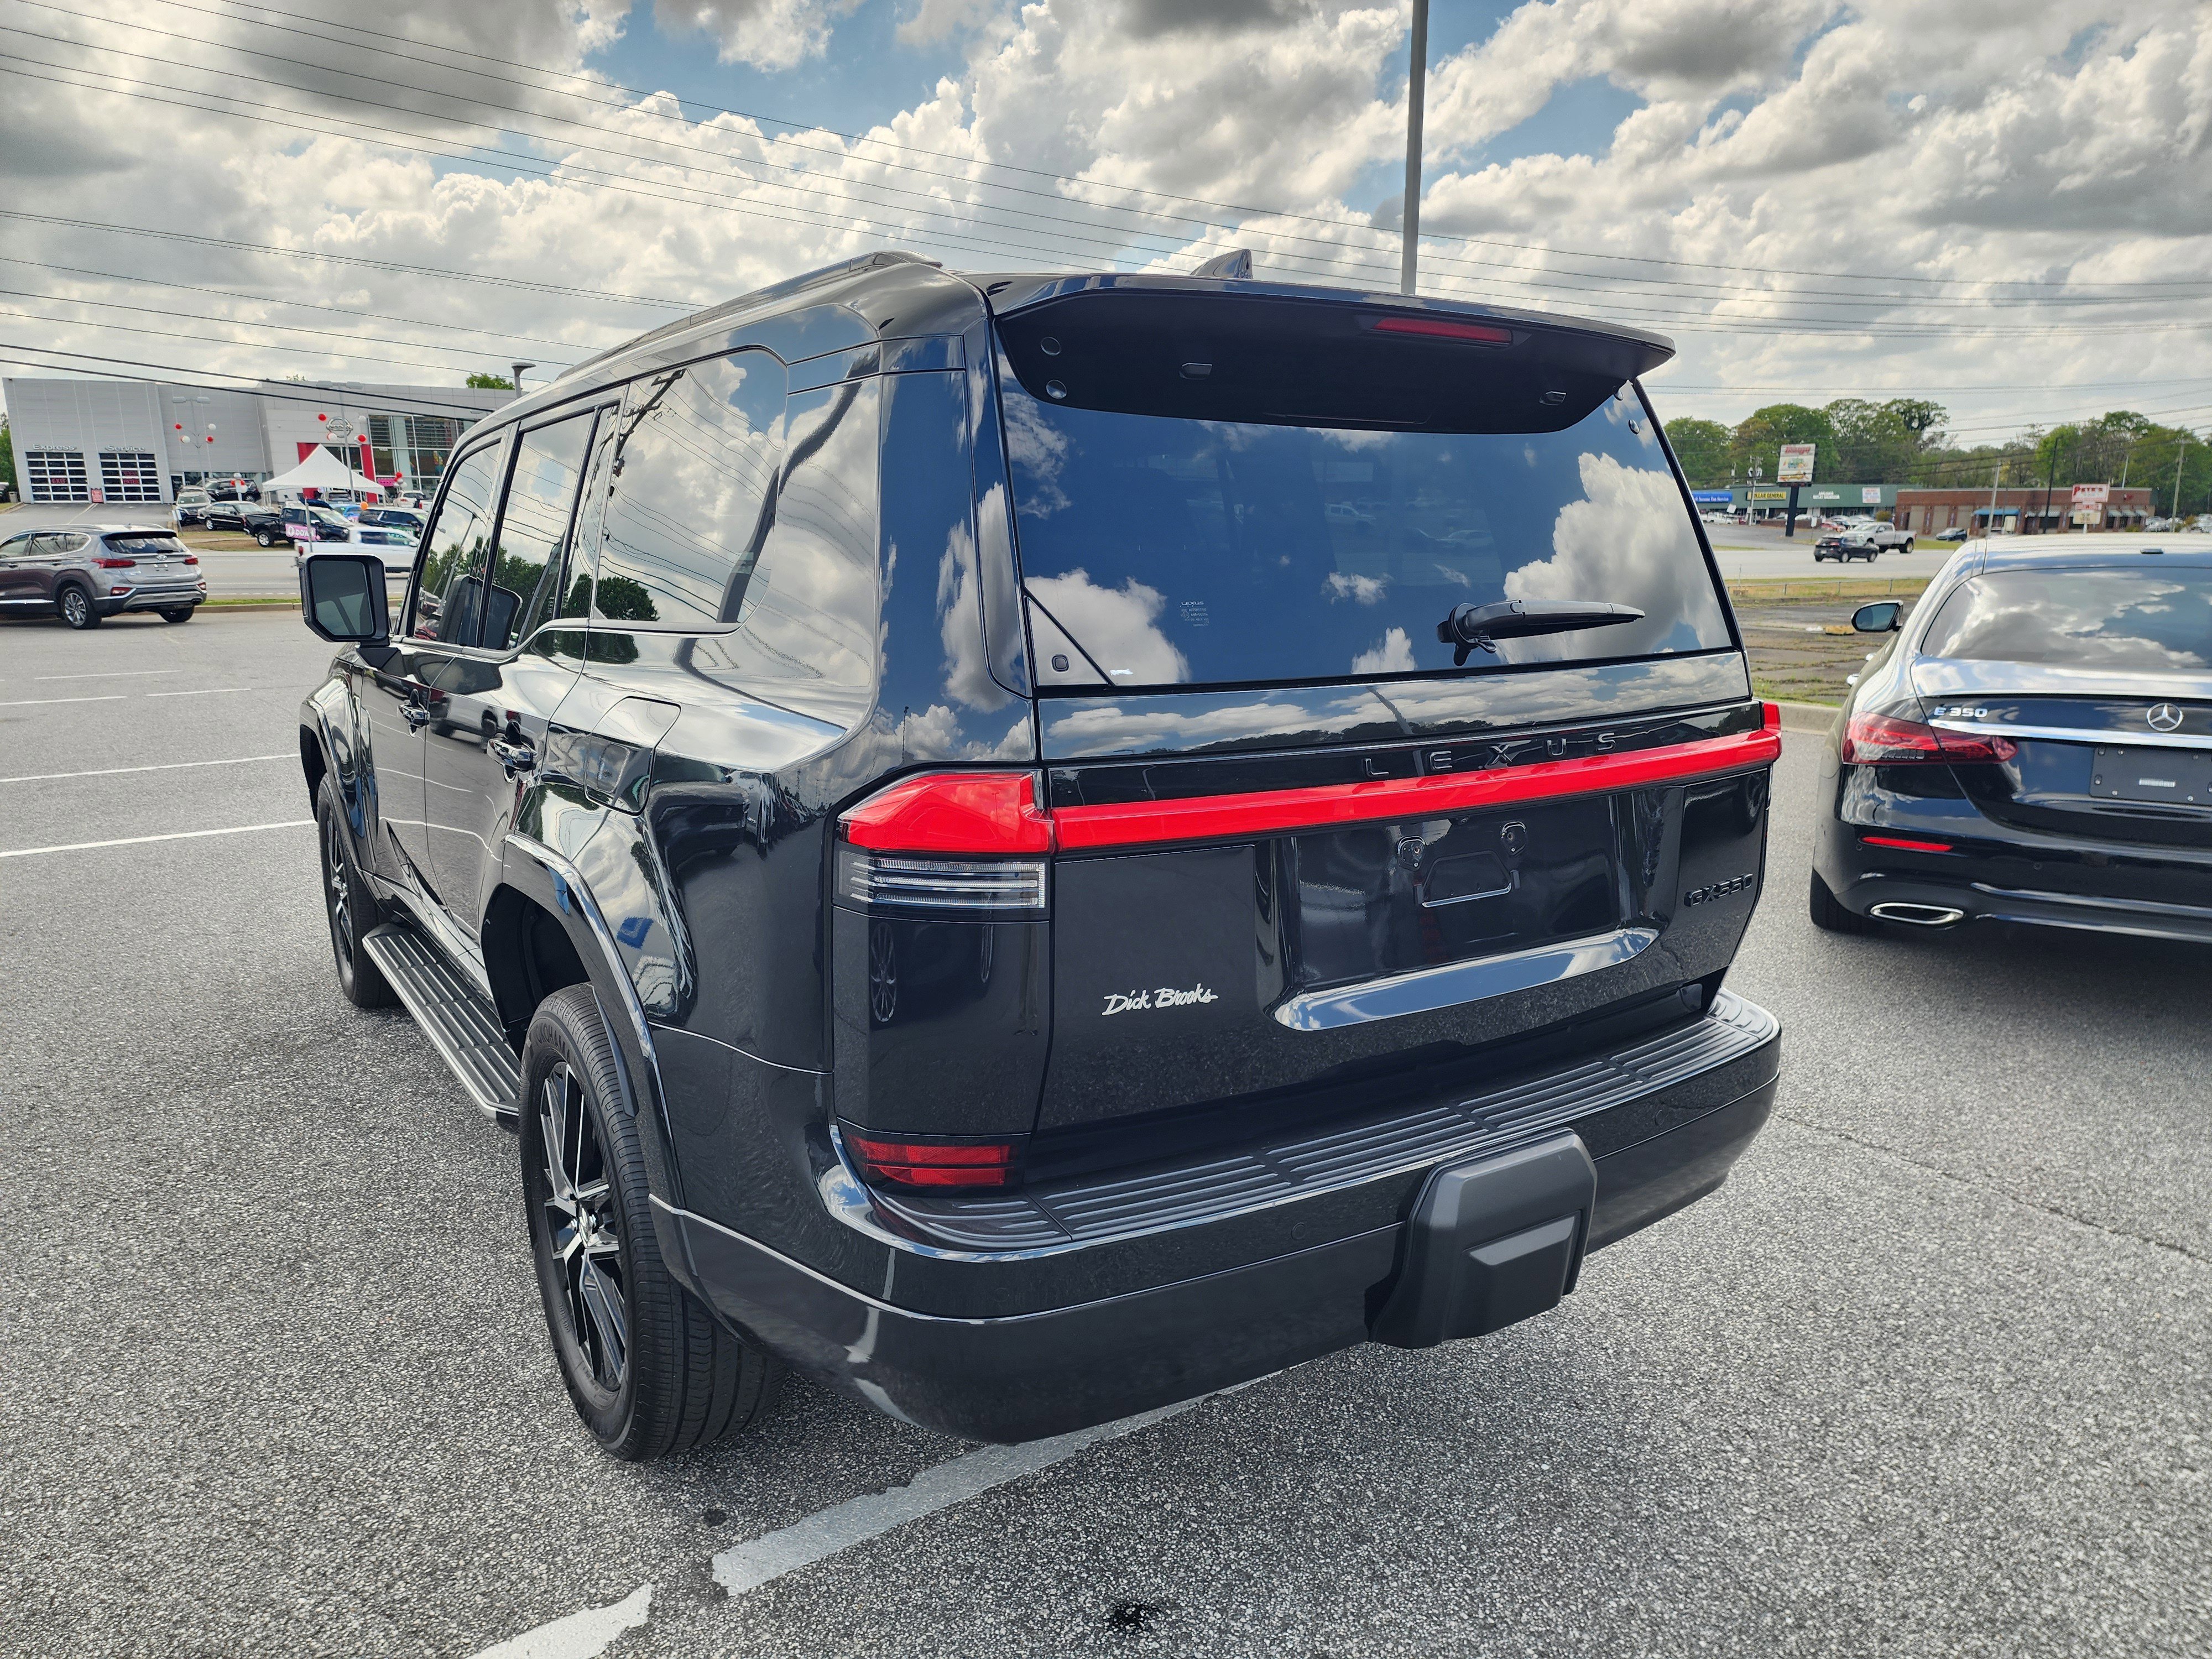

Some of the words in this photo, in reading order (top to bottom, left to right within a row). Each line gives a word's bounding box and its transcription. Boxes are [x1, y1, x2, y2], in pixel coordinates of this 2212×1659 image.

[1934, 707, 1947, 716] E
[1949, 707, 1988, 718] 350
[1364, 733, 1617, 776] LEXUS
[1685, 874, 1752, 906] GX550
[1102, 990, 1151, 1015] Dick
[1154, 983, 1218, 1008] Brooks
